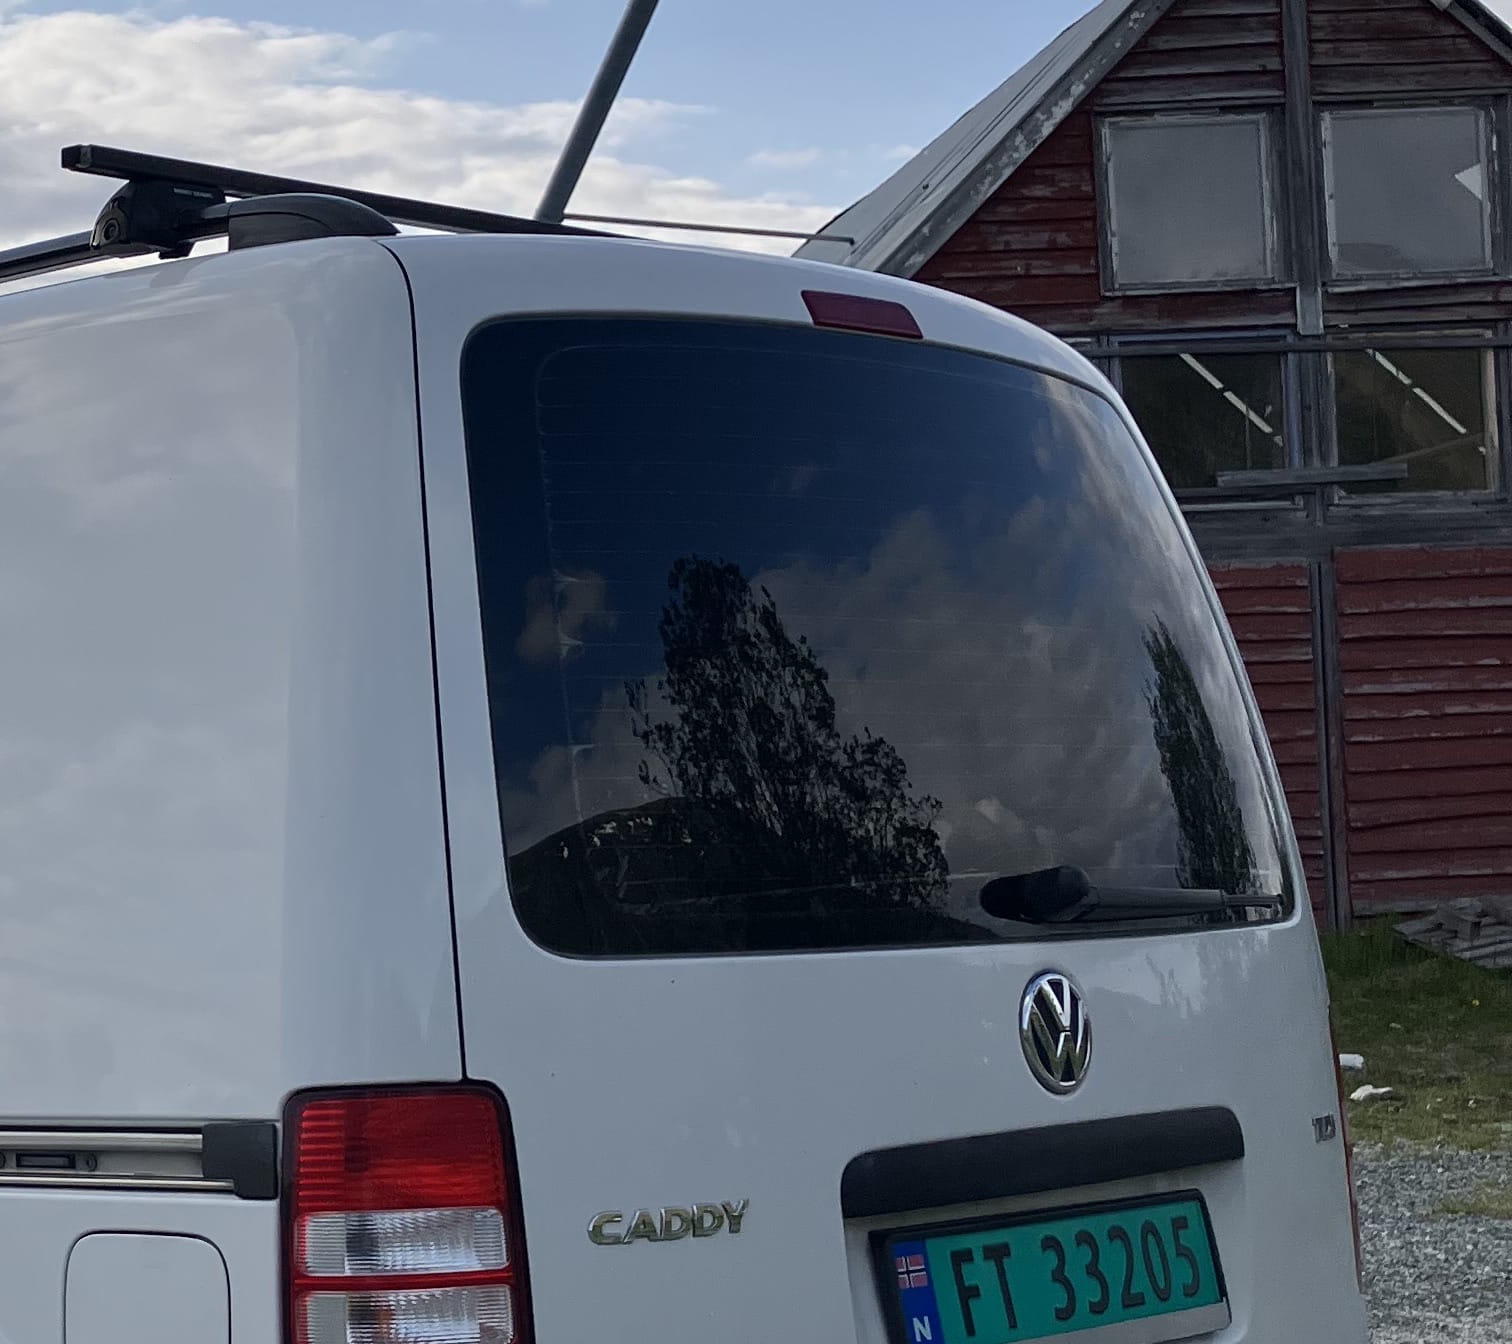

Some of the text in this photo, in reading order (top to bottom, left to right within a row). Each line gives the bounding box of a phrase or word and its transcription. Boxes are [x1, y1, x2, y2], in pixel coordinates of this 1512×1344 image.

[1021, 971, 1090, 1090] VW
[587, 1198, 749, 1245] CADDY
[949, 1215, 1200, 1337] FT 33205
[912, 1315, 933, 1343] N
